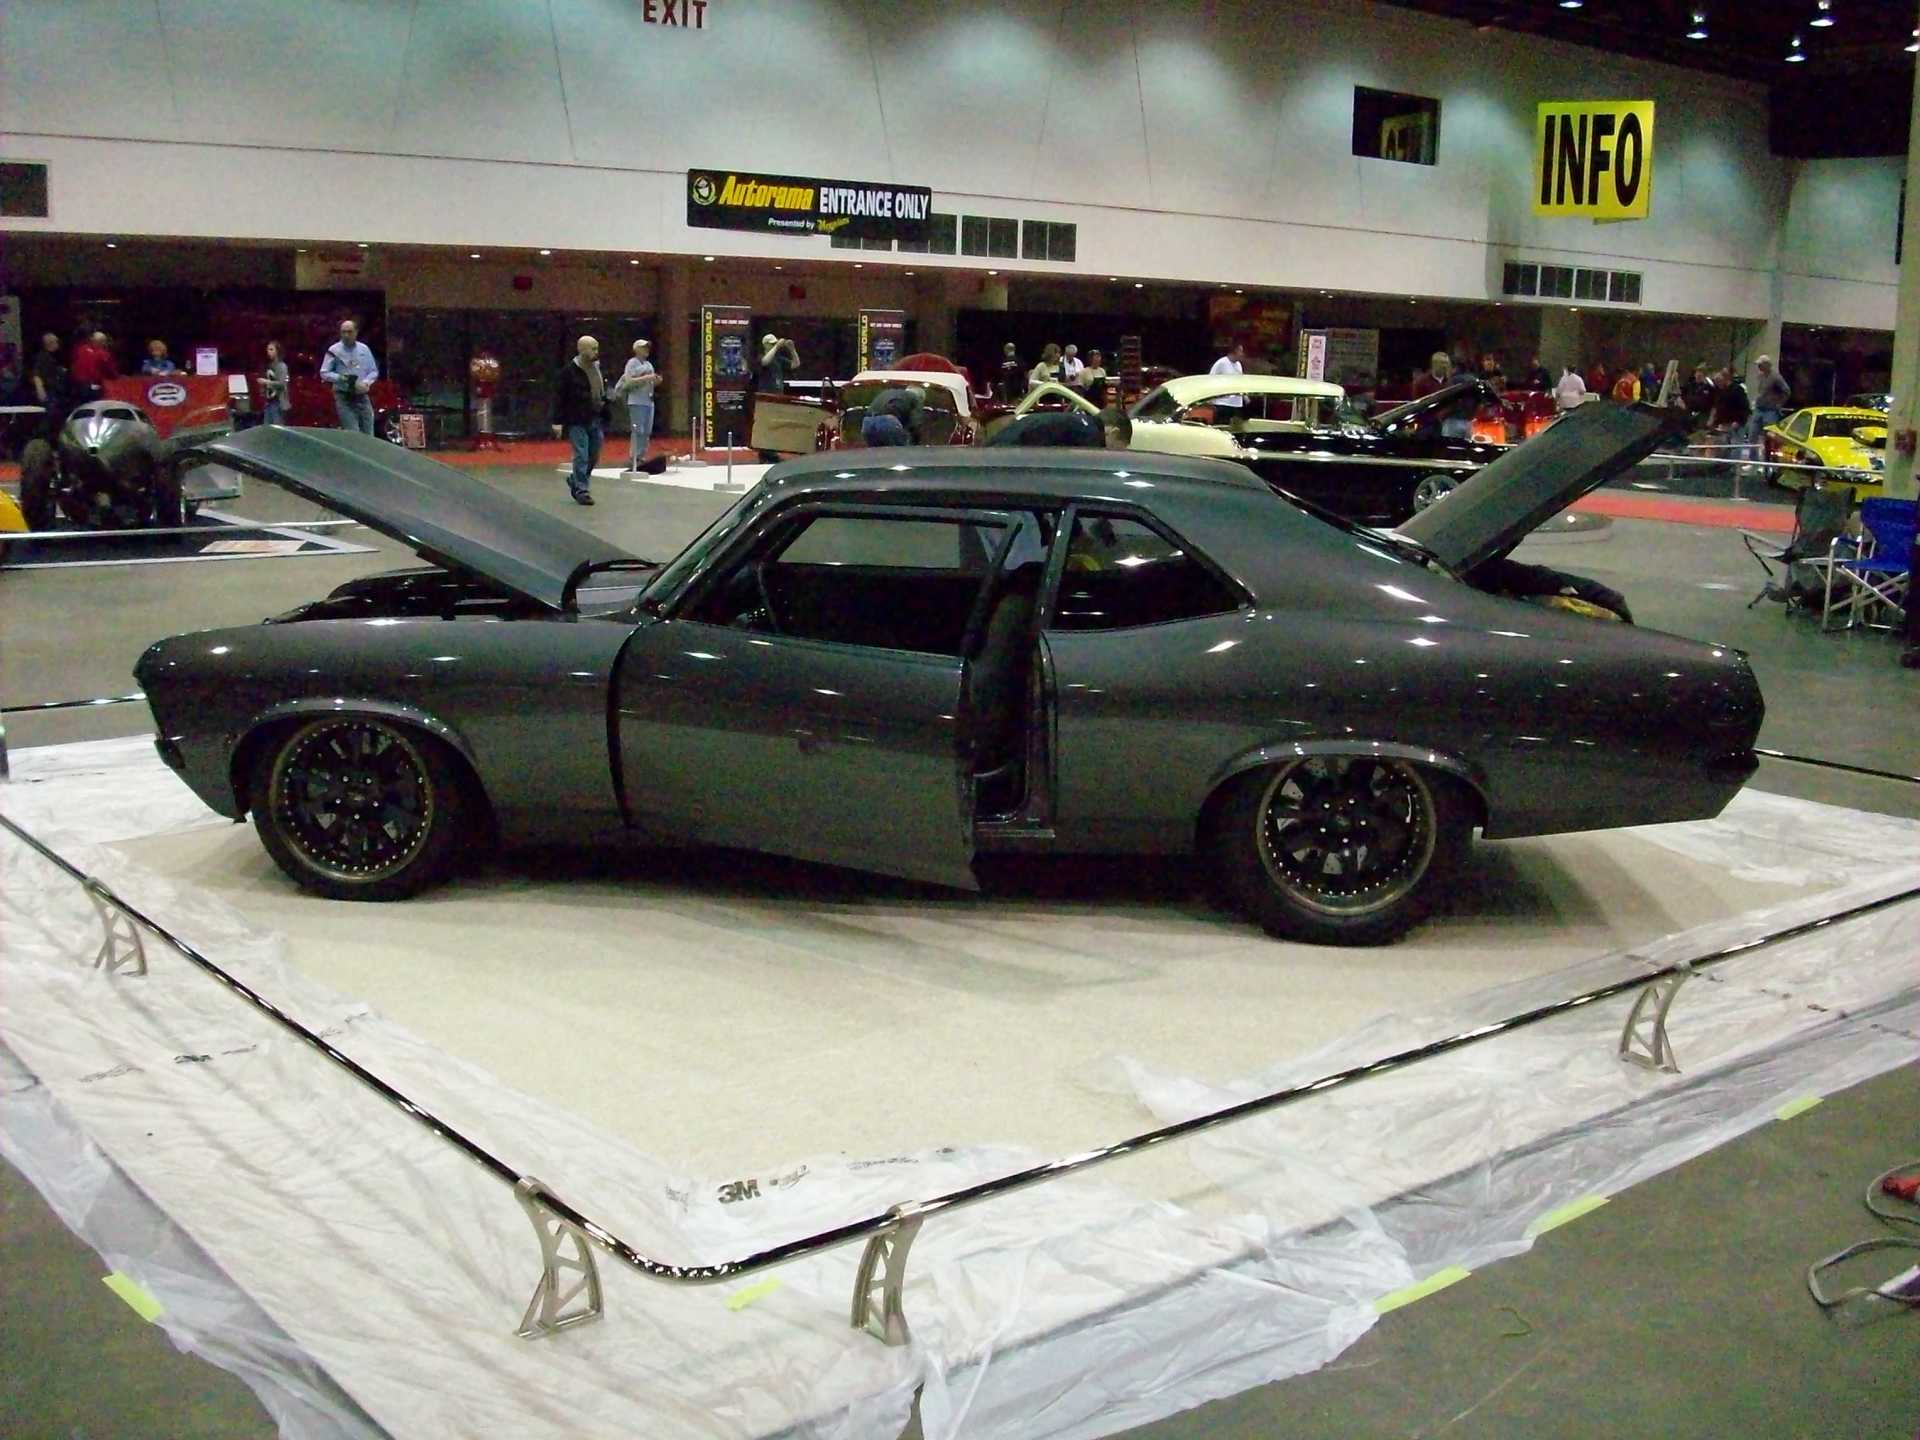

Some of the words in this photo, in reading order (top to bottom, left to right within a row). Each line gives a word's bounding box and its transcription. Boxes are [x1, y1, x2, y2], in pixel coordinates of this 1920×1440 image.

[643, 0, 708, 29] EXIT
[1541, 111, 1643, 208] INFO
[719, 175, 815, 210] Autorama
[819, 186, 893, 218] ENTRANCE
[894, 192, 929, 220] ONLY
[767, 217, 804, 229] Presented
[805, 219, 817, 231] by
[704, 311, 713, 352] WORLD
[704, 355, 713, 389] SHOW
[705, 391, 713, 417] ROD
[705, 418, 714, 443] HOT
[716, 1179, 762, 1205] 3M
